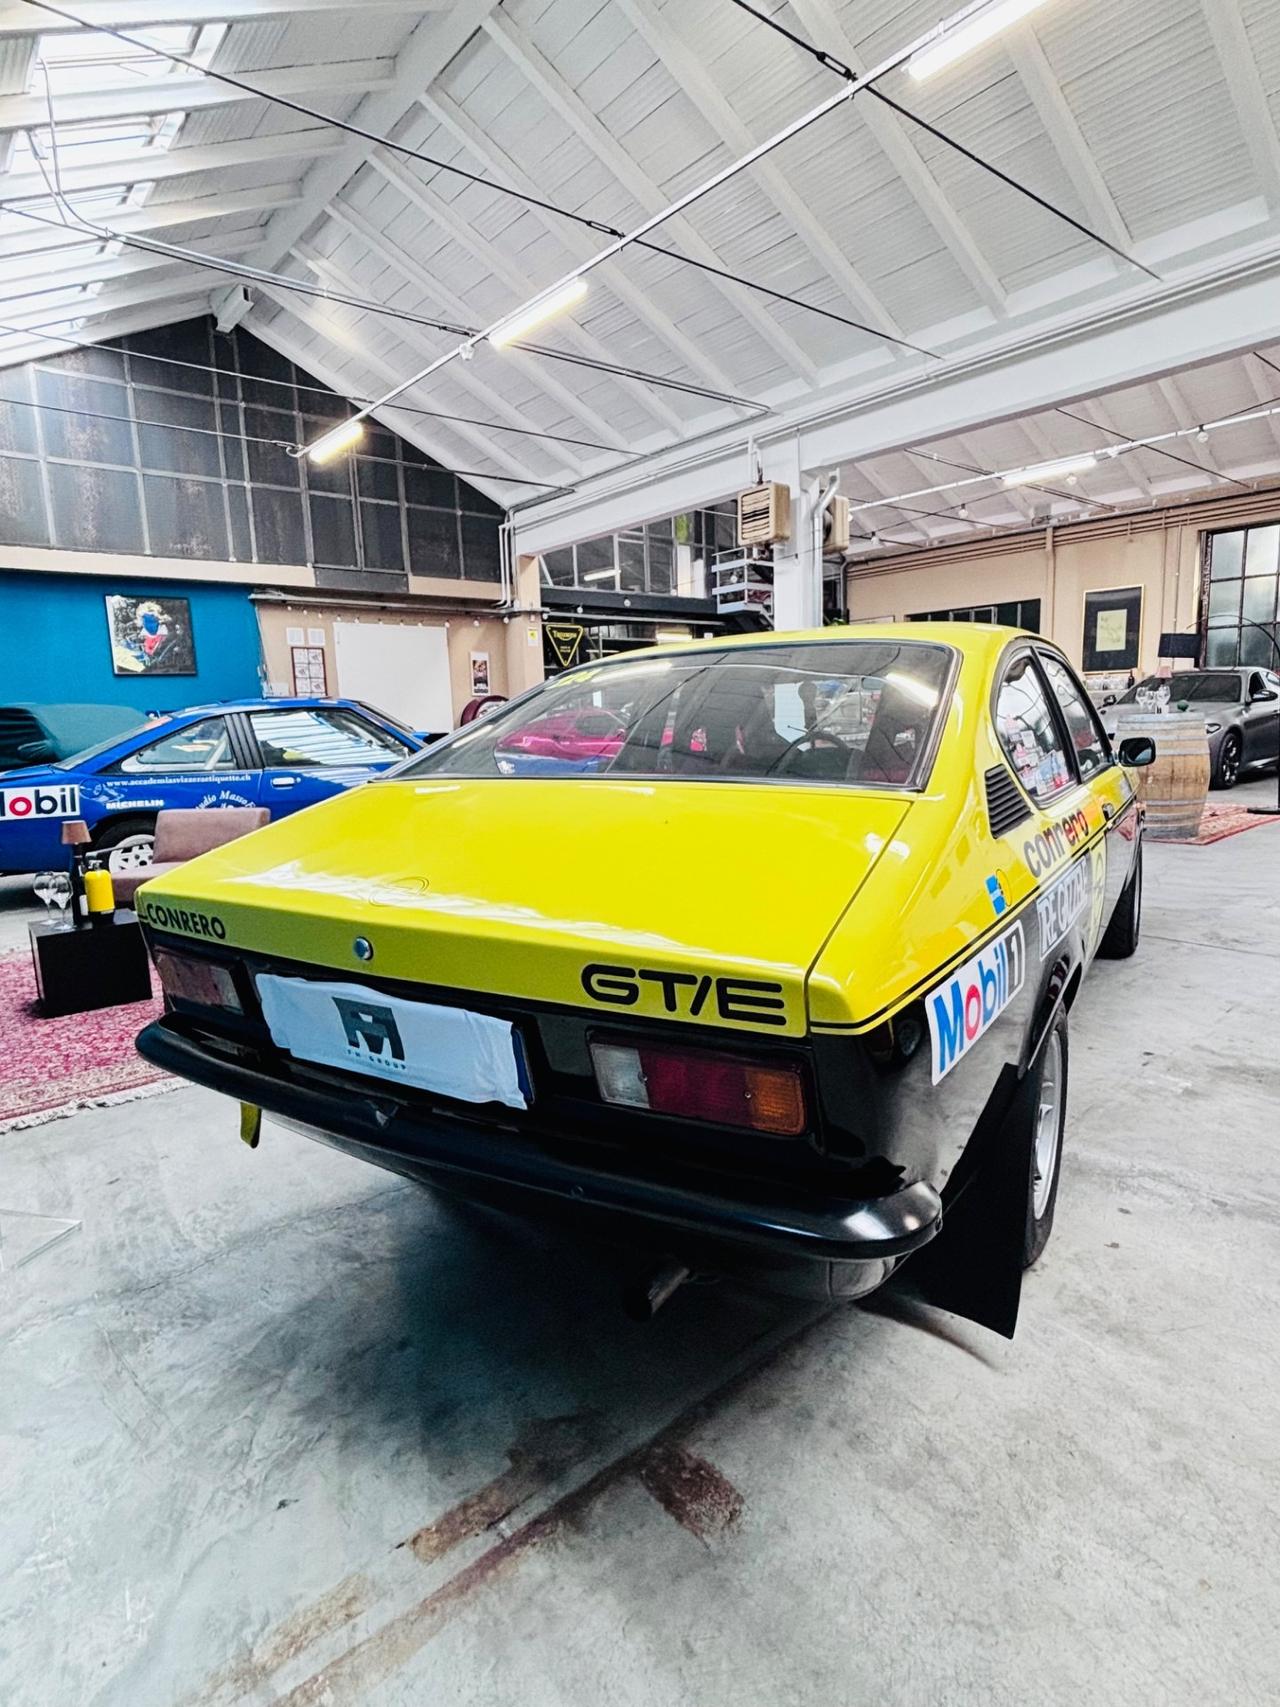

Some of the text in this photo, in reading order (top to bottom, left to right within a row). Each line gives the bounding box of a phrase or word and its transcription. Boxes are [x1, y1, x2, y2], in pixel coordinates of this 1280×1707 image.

[105, 800, 165, 810] MICHELIN
[1023, 810, 1089, 878] conrero
[146, 903, 226, 940] CONRERO
[581, 963, 787, 1026] GT/E
[933, 934, 1019, 1074] Mobil 1
